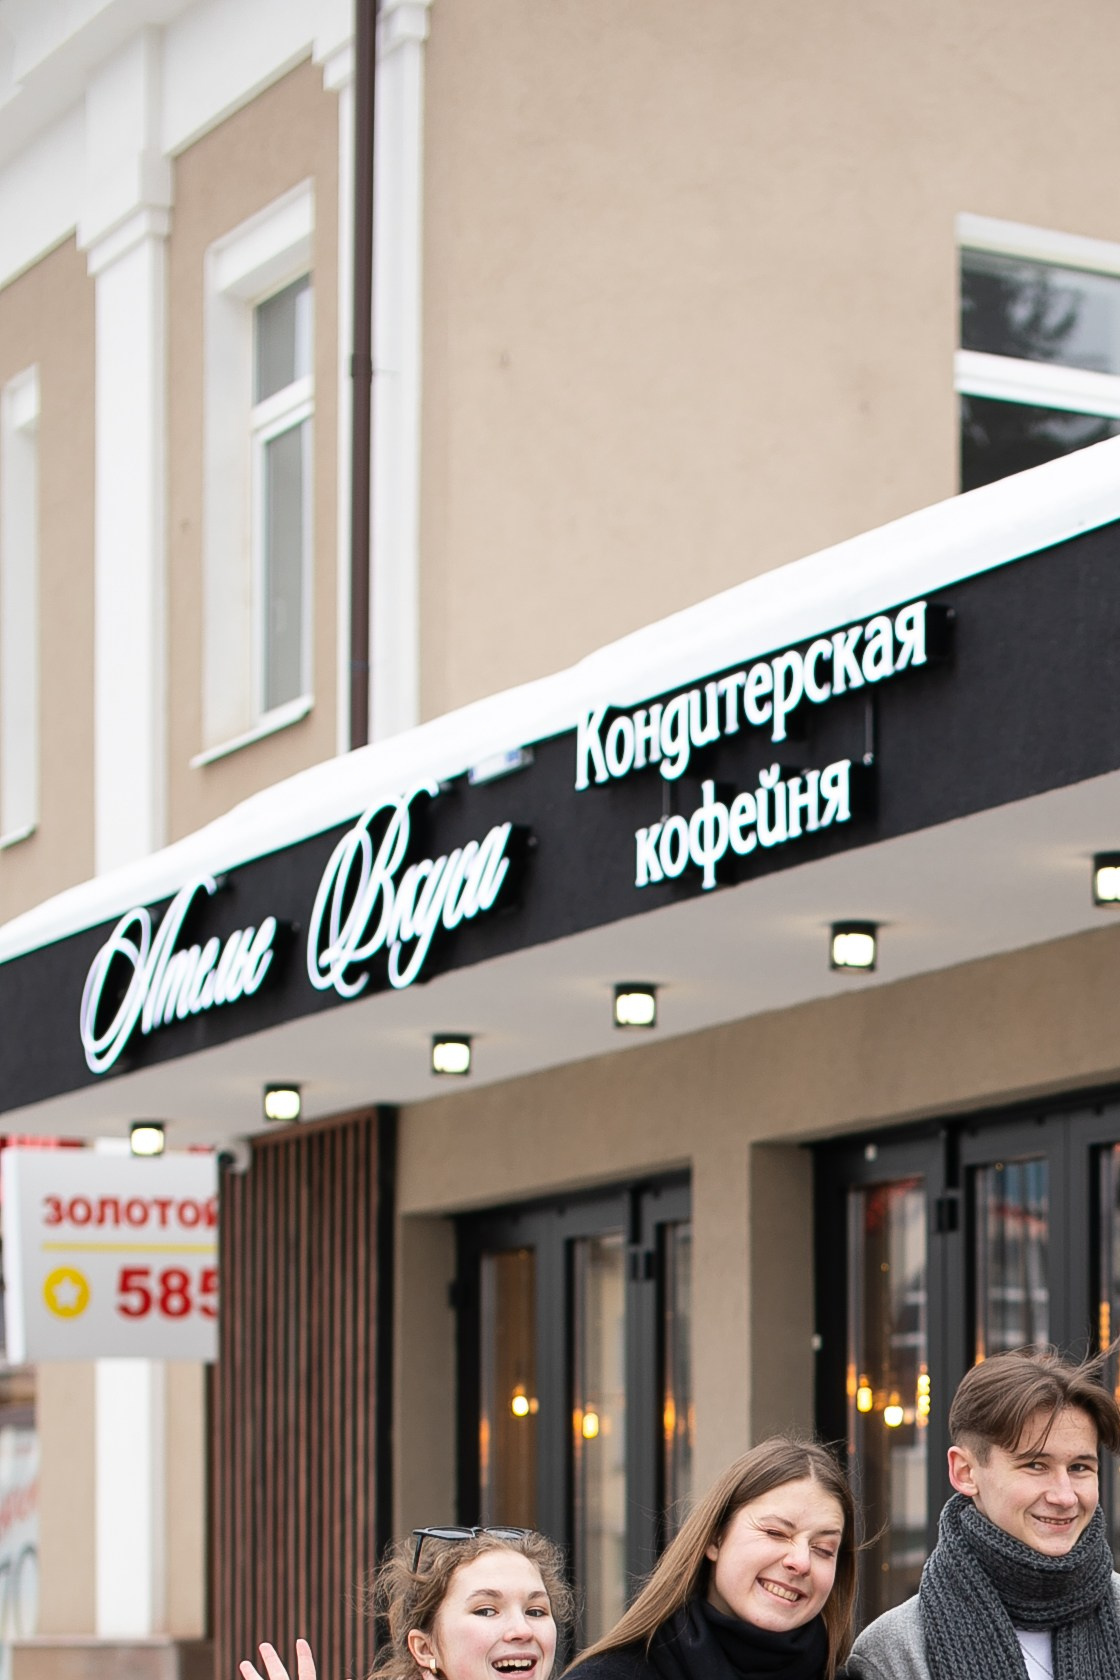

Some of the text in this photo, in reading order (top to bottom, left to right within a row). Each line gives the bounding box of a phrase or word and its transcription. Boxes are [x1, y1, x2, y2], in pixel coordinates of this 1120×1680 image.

[574, 600, 928, 792] Кондитерская
[306, 778, 513, 998] Вкуса
[634, 759, 853, 891] кофейня
